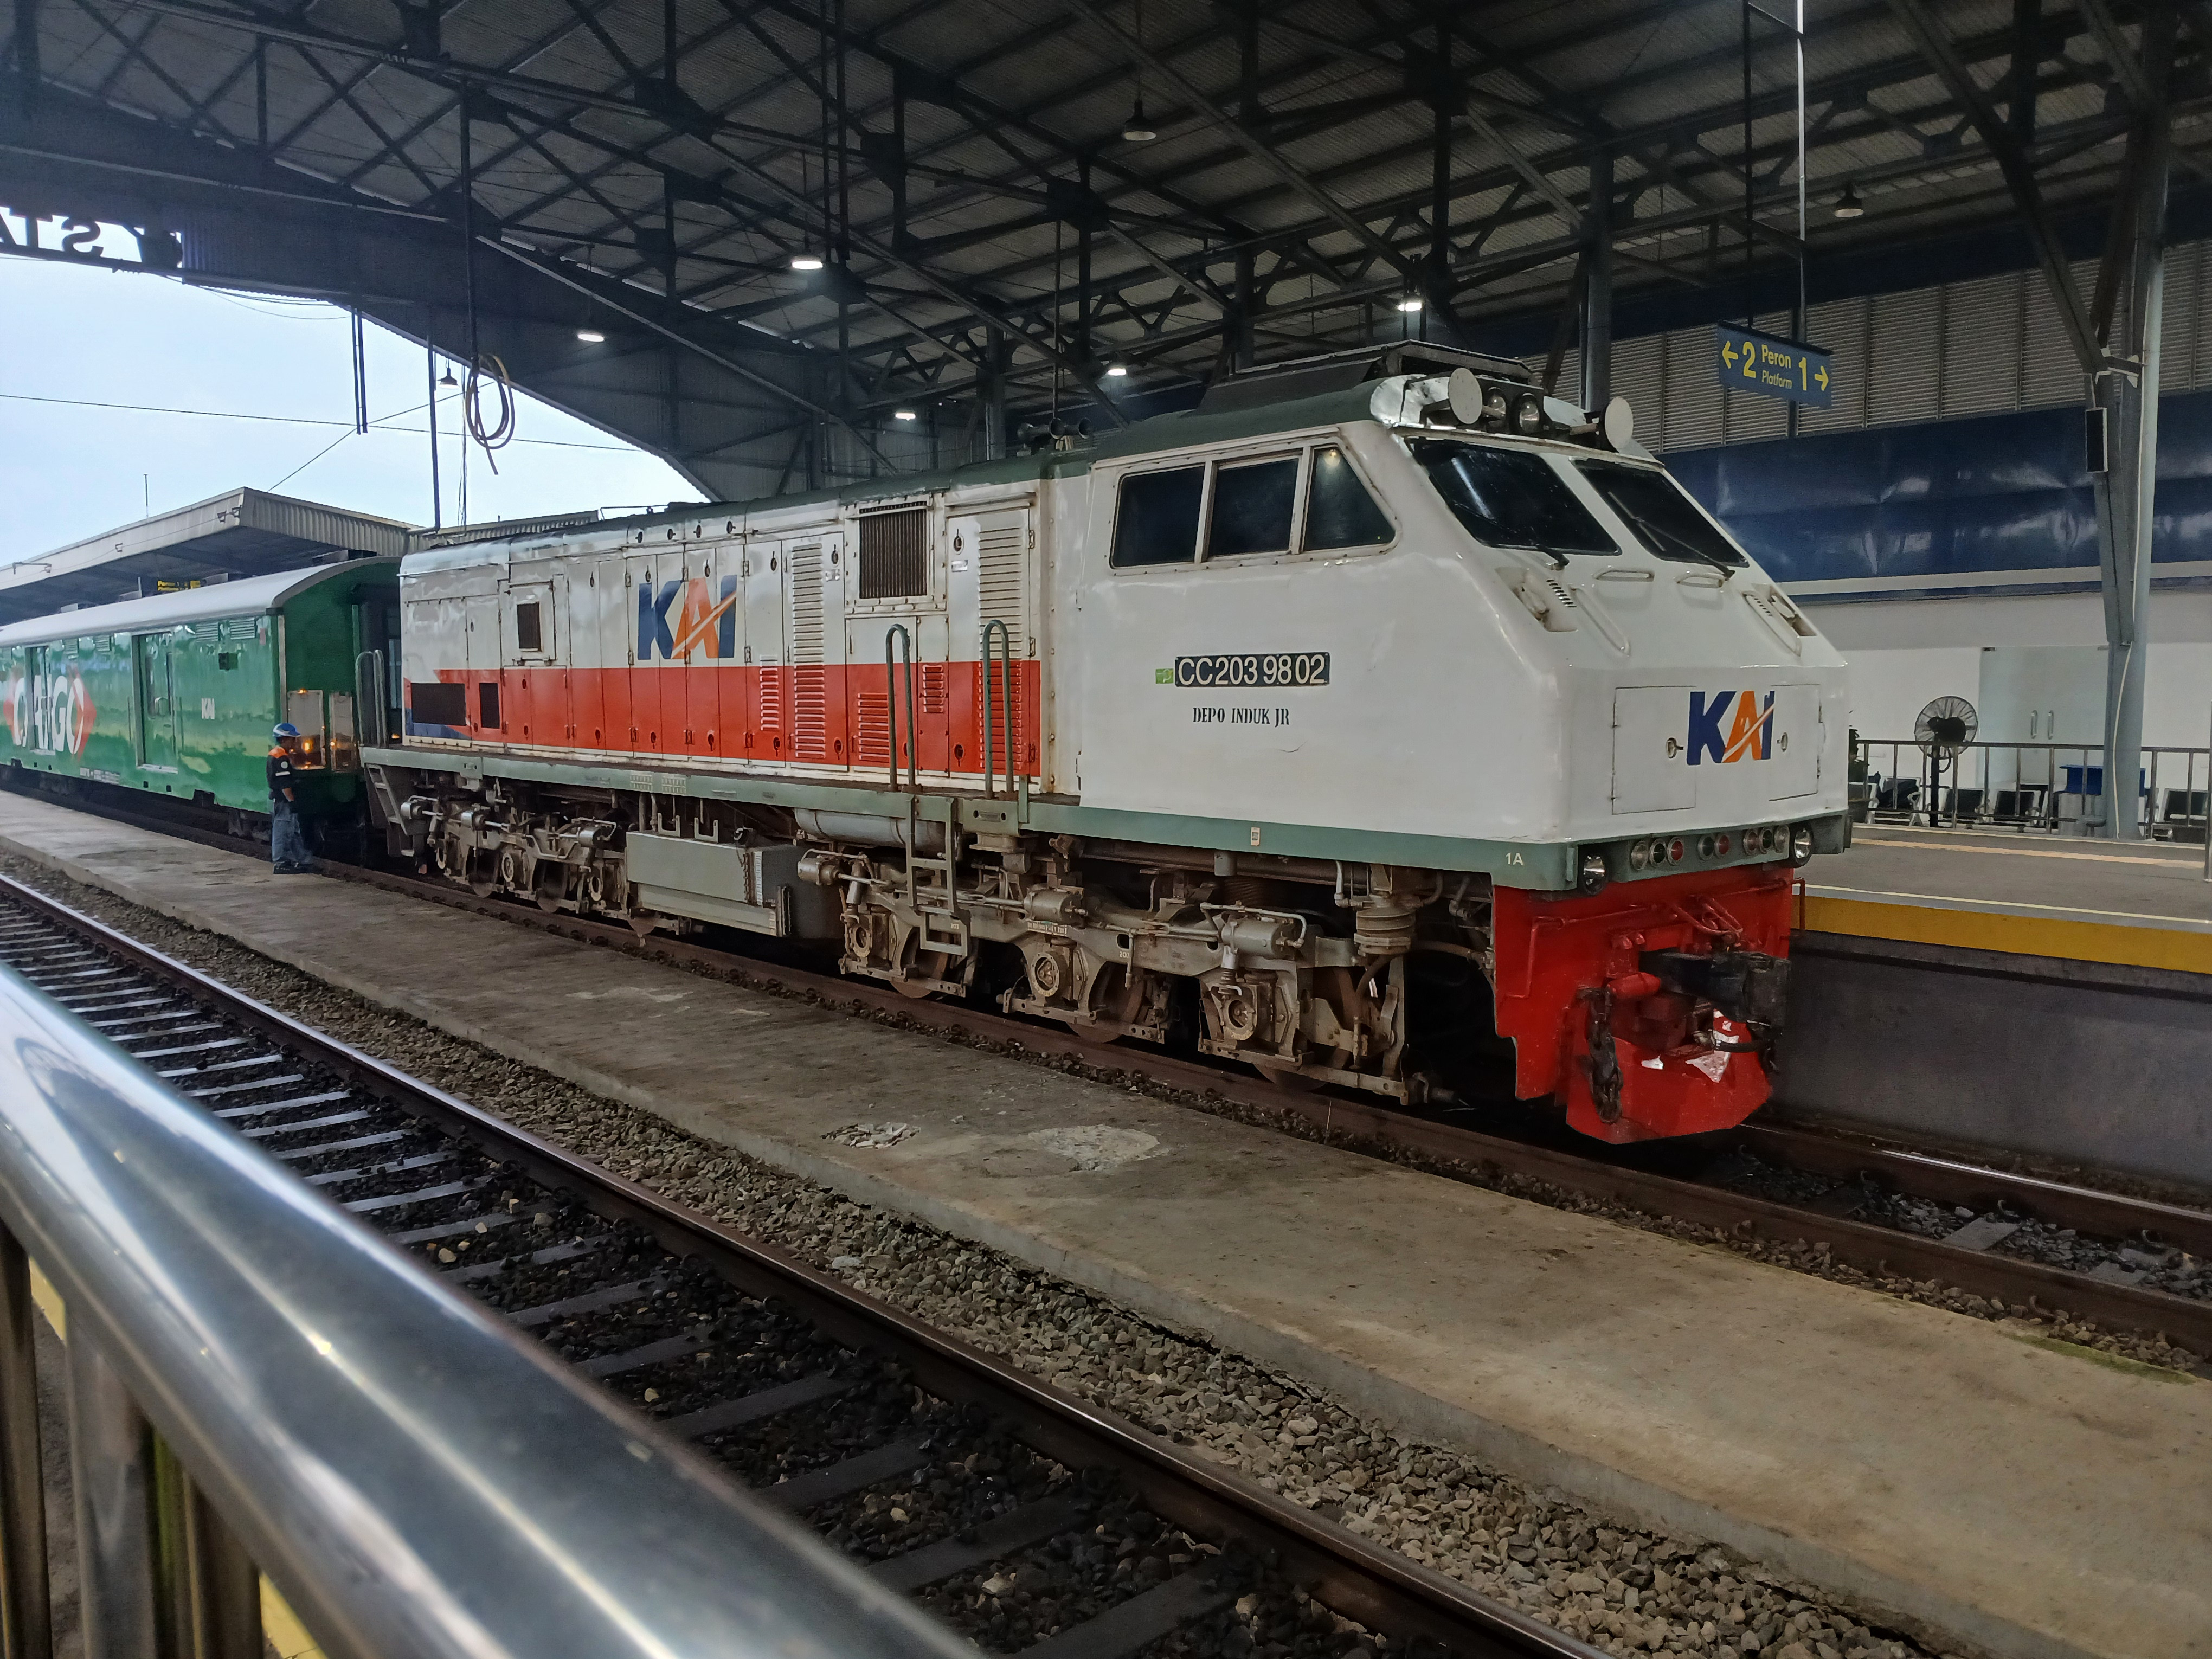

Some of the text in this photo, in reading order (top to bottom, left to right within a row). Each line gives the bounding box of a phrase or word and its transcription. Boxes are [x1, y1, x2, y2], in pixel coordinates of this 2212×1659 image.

[1742, 341, 1807, 391] 2 Peron 1
[1761, 370, 1792, 389] Platform
[638, 575, 737, 660] KAI
[1193, 707, 1290, 728] DEPO INDUK JR
[1687, 690, 1775, 766] KAI
[1505, 852, 1524, 866] 1A
